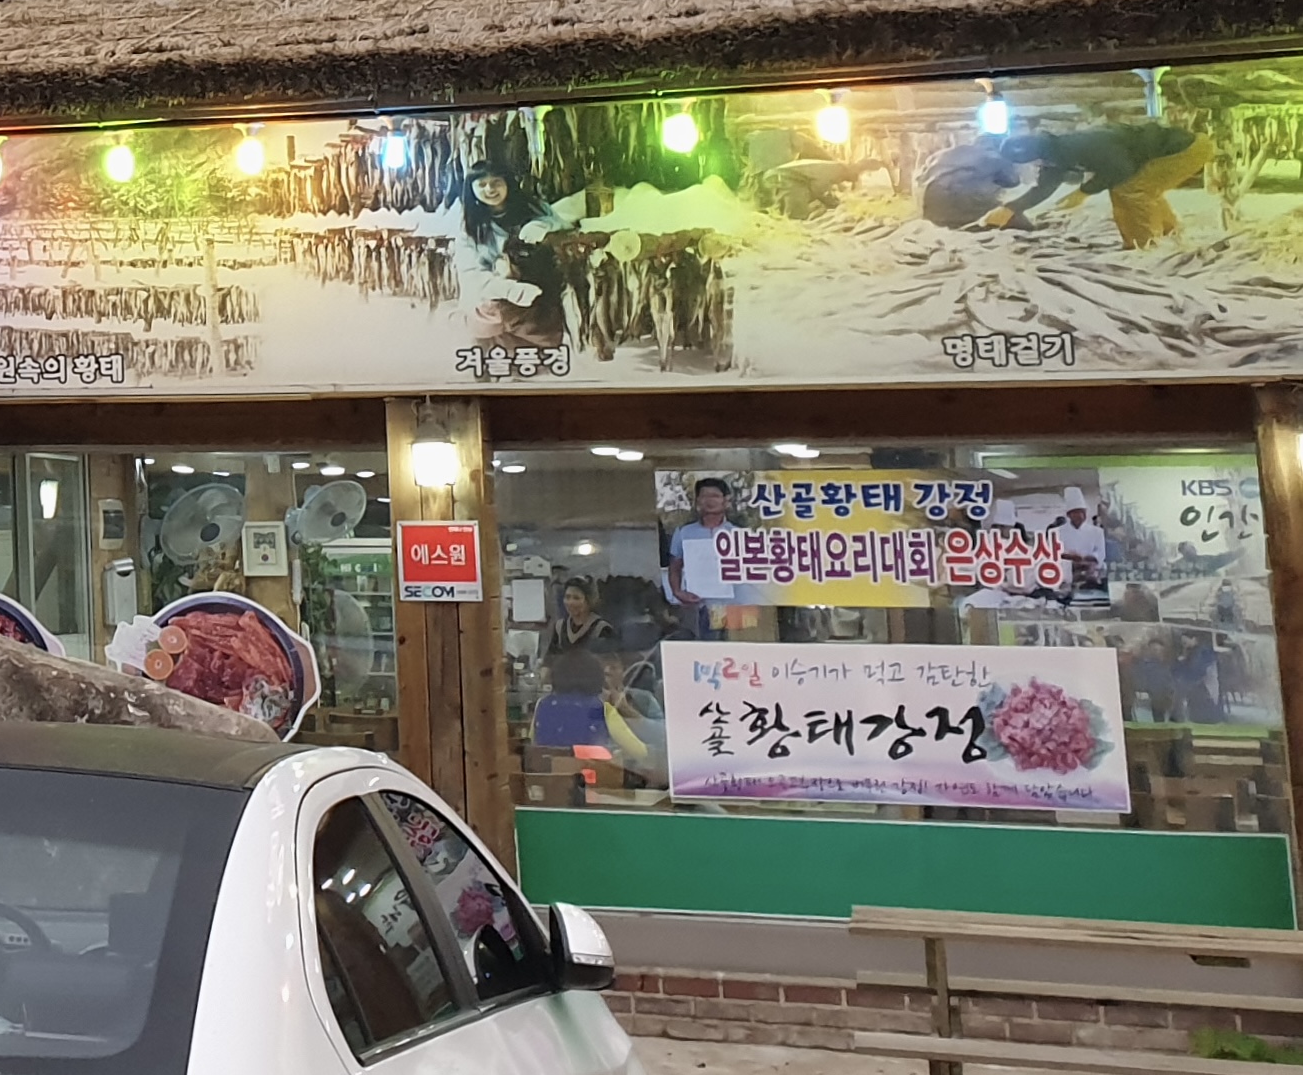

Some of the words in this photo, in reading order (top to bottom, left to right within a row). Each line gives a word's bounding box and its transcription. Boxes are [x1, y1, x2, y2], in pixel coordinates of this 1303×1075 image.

[72, 352, 126, 385] 황태
[749, 480, 904, 520] 산골황태
[912, 479, 993, 520] 강정
[1181, 479, 1233, 496] KBS
[410, 544, 466, 566] 에스원
[714, 527, 937, 585] 일본황태요리대회
[944, 528, 1064, 588] 은상수상
[405, 585, 455, 599] SECOM
[771, 659, 852, 686] 이승기가
[863, 660, 906, 685] 먹고
[916, 660, 992, 687] 감탄한
[739, 700, 988, 764] 황태강정
